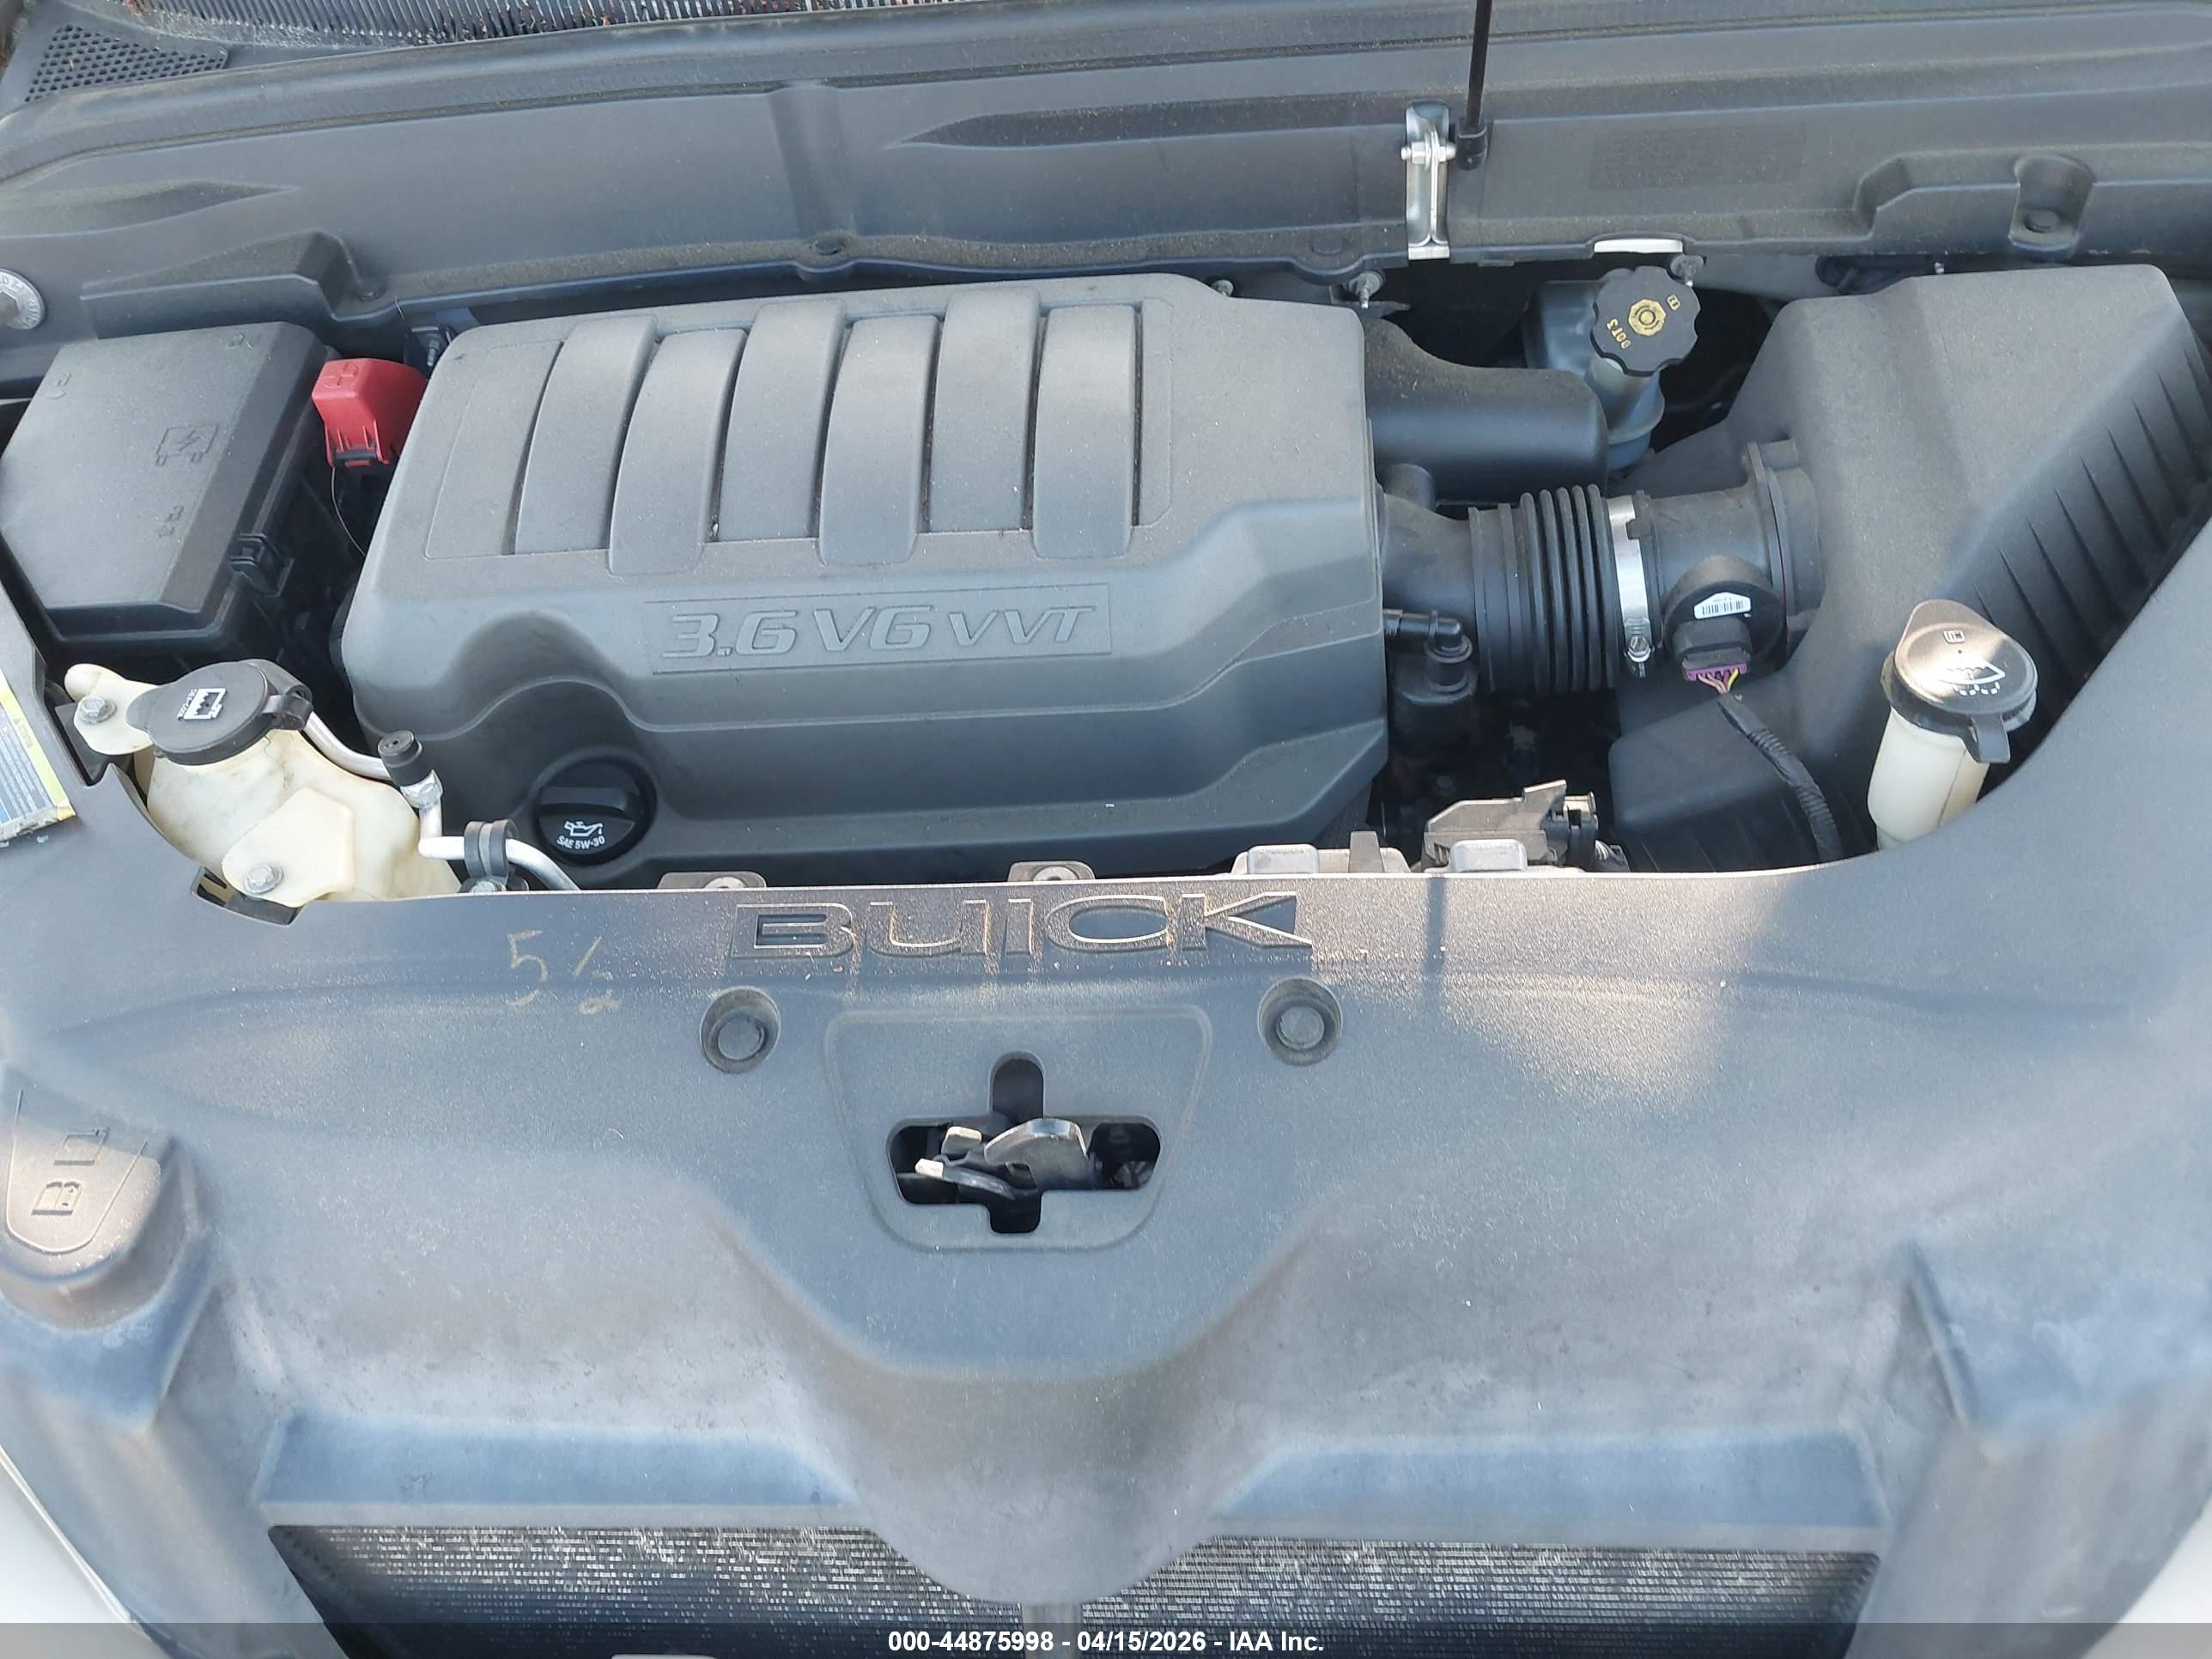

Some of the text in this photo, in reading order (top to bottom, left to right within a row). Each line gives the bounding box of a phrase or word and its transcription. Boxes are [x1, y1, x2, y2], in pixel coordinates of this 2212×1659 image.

[662, 604, 1096, 659] 3.6 V6 VVT
[556, 835, 605, 850] SAE 5W-30
[730, 891, 1313, 957] BUICK
